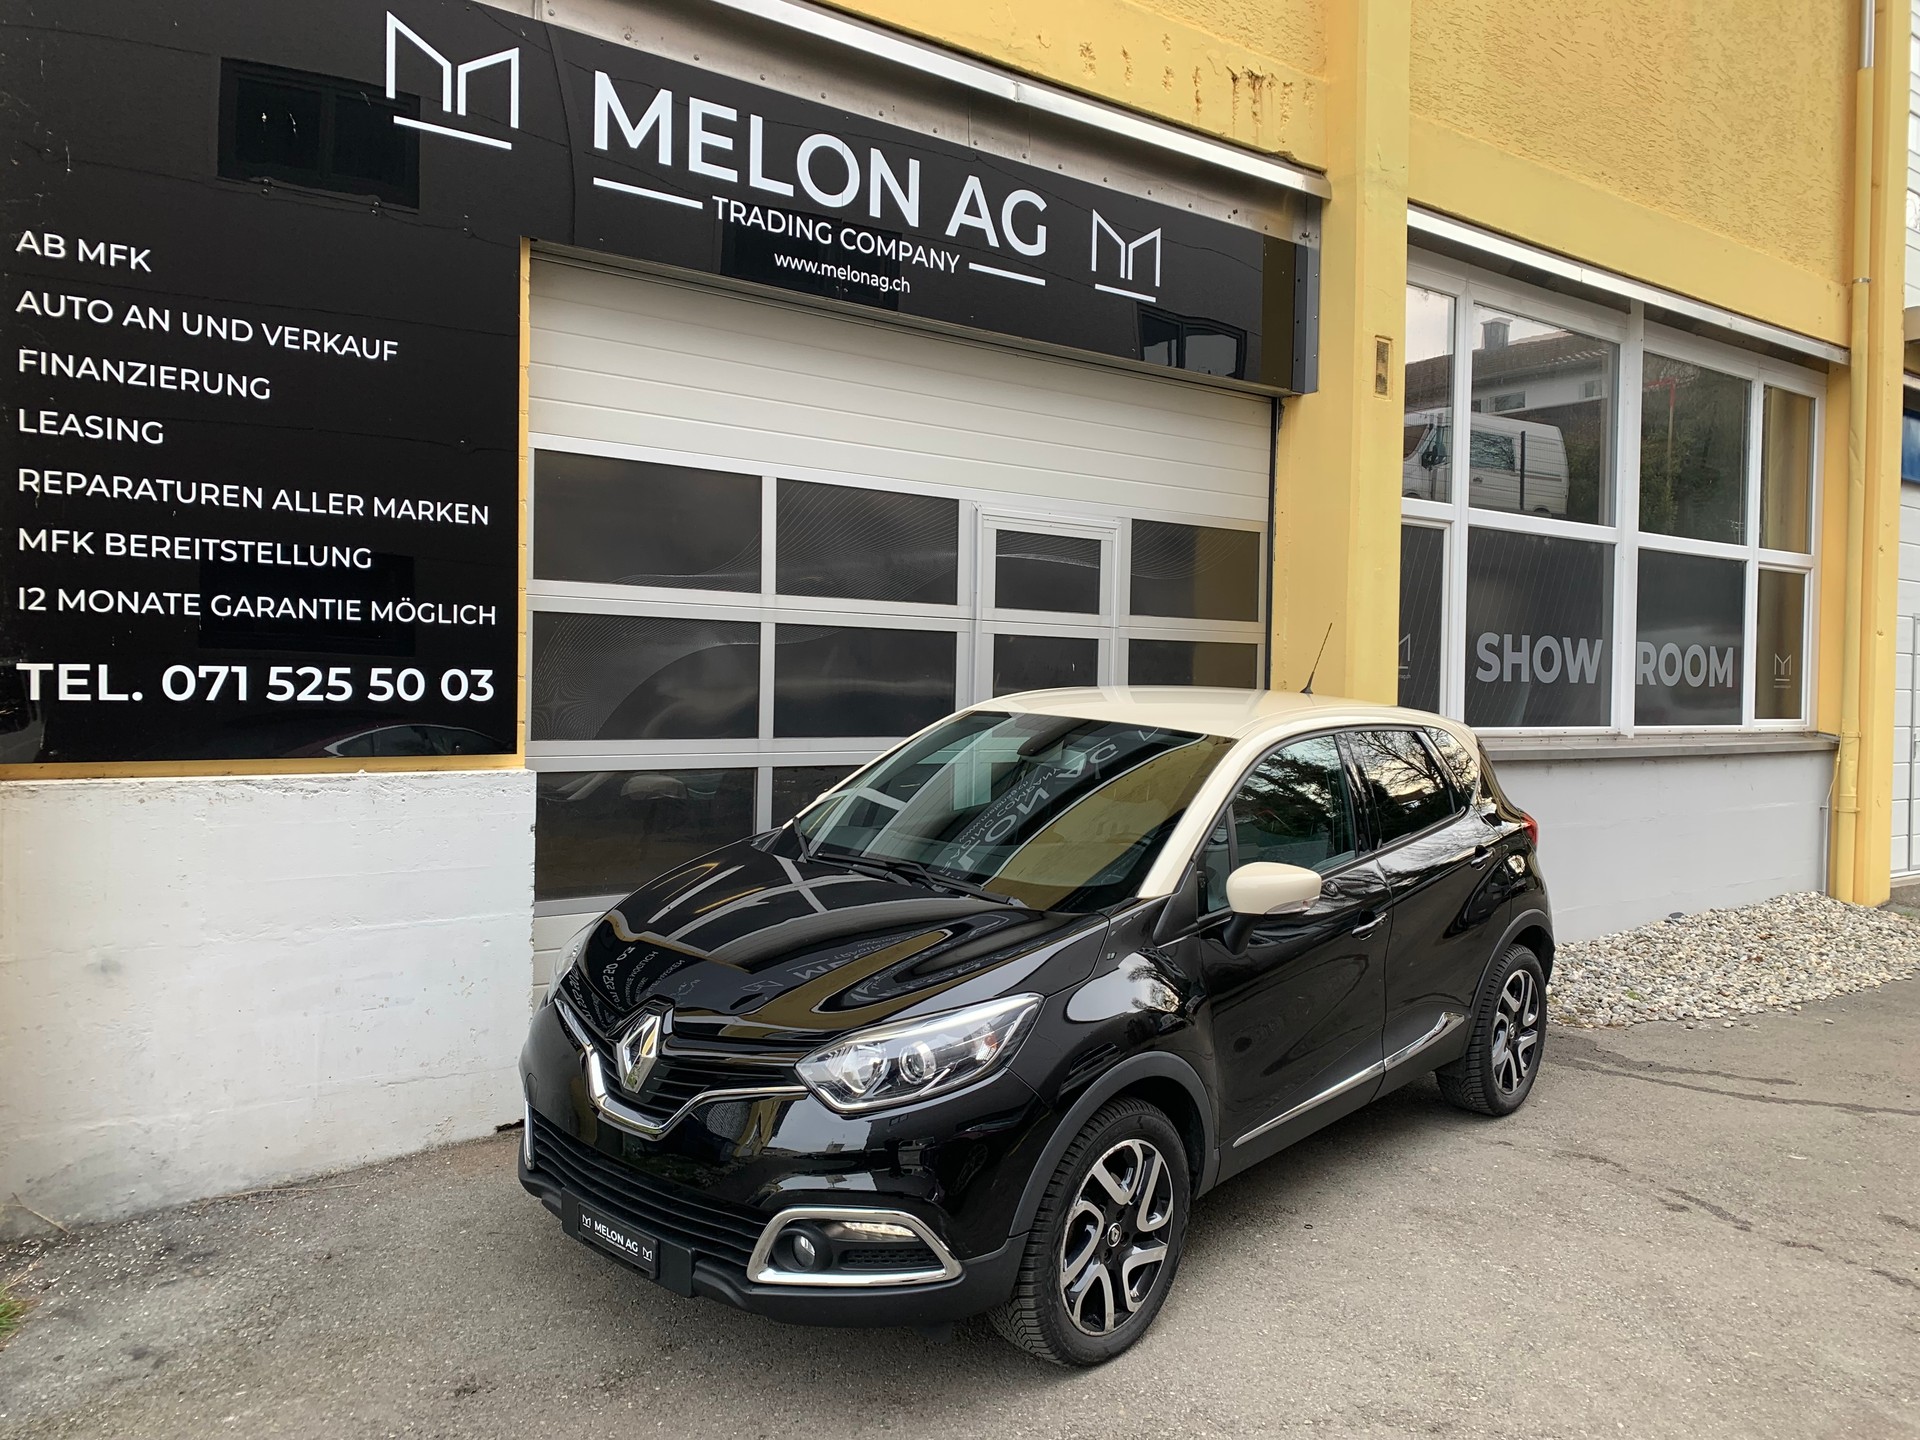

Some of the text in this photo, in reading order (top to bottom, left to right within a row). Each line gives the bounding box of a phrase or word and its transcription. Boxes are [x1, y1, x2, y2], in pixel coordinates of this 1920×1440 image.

[593, 70, 1048, 257] MELON AG
[15, 230, 152, 273] AB MFK
[712, 195, 960, 274] TRADING COMPANY
[774, 253, 910, 294] www.melonag.ch
[15, 290, 399, 361] AUTO AN UND VERKAUF
[18, 348, 271, 400] FINANZIERUNG
[18, 408, 164, 445] LEASING
[18, 468, 489, 526] REPARATUREN ALLER MARKEN
[18, 527, 372, 569] MFK BEREITSTELLUNG
[58, 588, 201, 616] MONATE
[210, 594, 362, 621] GARANTIE
[371, 597, 496, 626] MÖGLICH
[1475, 631, 1734, 688] SHOW ROOM
[15, 662, 495, 702] TEL. 071 525 50 03
[594, 1220, 624, 1246] MELON
[625, 1238, 639, 1253] AG
